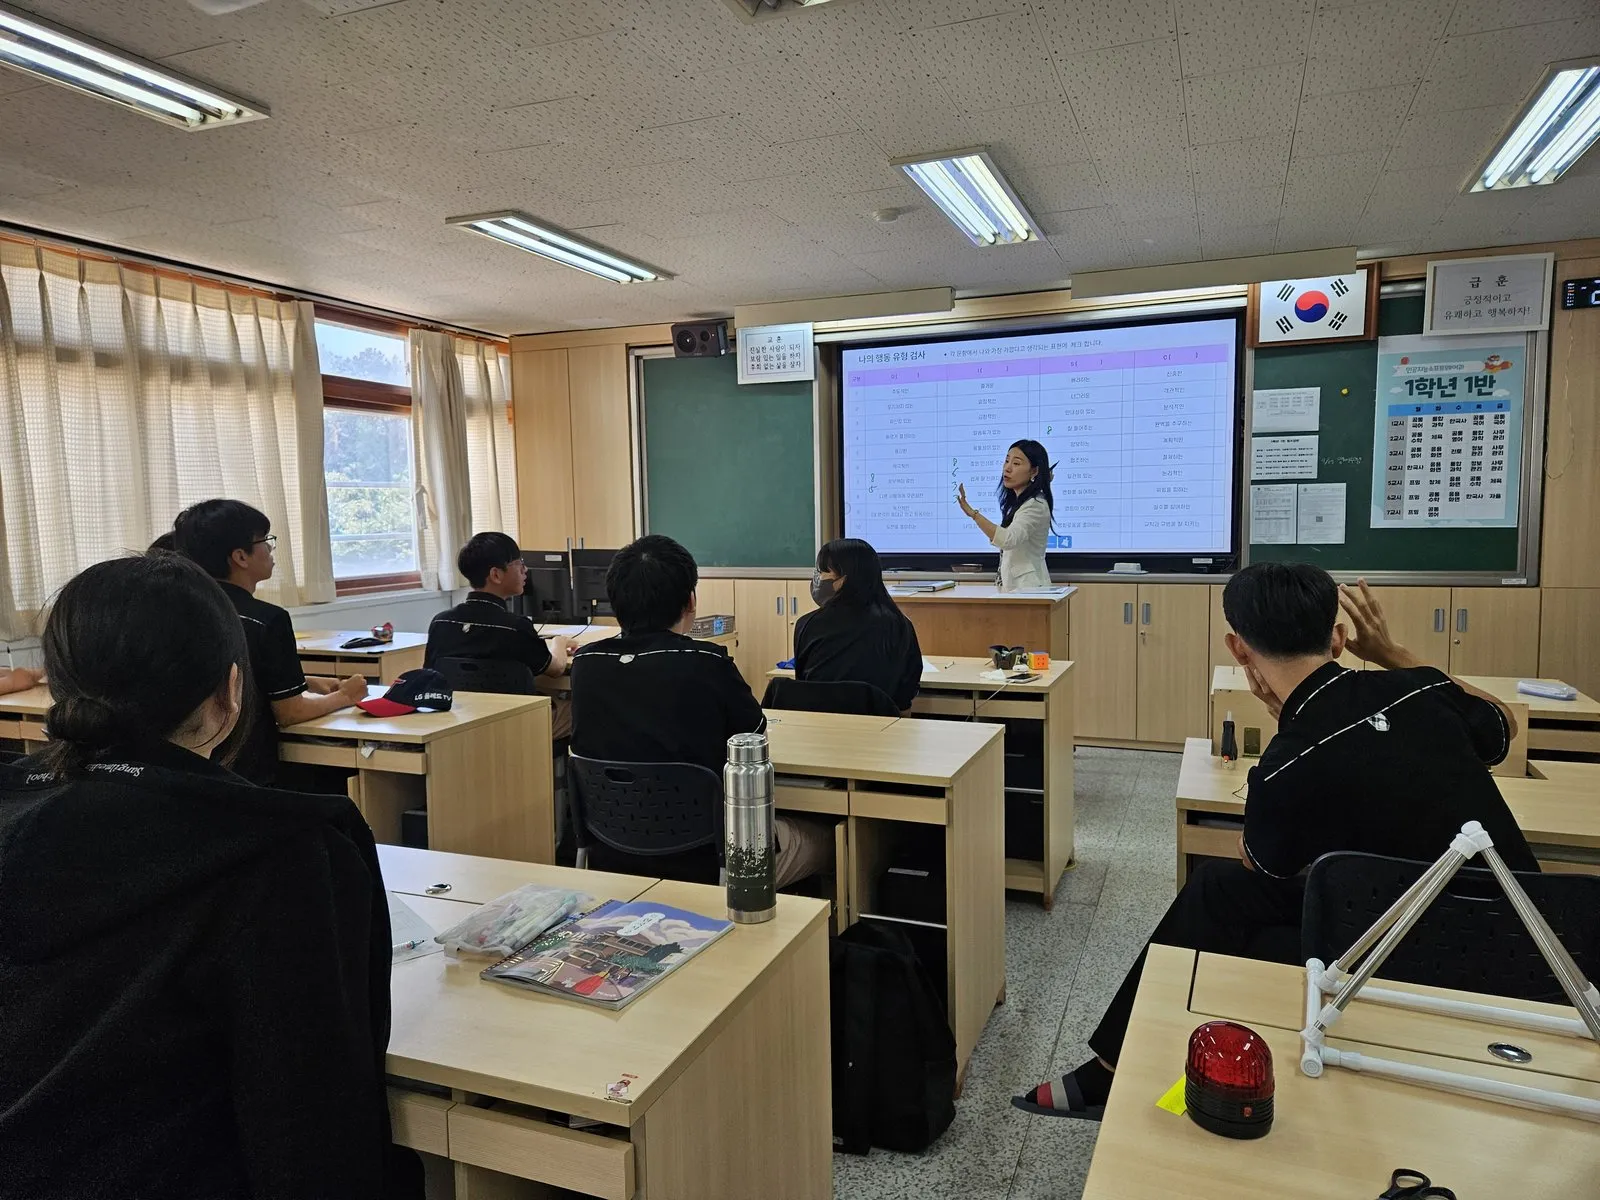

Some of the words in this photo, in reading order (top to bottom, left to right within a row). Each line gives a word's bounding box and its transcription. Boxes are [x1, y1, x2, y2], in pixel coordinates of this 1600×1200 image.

[1469, 276, 1482, 289] 급
[1495, 274, 1508, 287] 훈
[1463, 294, 1512, 305] 긍정적이고
[1443, 308, 1482, 320] 유쾌하고
[1487, 306, 1531, 319] 행복하자!
[769, 344, 786, 353] 사람이
[789, 343, 801, 351] 되자
[763, 354, 774, 362] 있는
[776, 353, 787, 361] 일을
[789, 352, 801, 360] 하자
[859, 354, 874, 364] 나의
[875, 353, 891, 363] 행동
[892, 352, 908, 362] 유형
[910, 350, 926, 361] 검사
[763, 362, 774, 370] 없는
[1405, 376, 1458, 399] 1학년
[1464, 375, 1496, 397] 1반
[414, 693, 423, 701] LG
